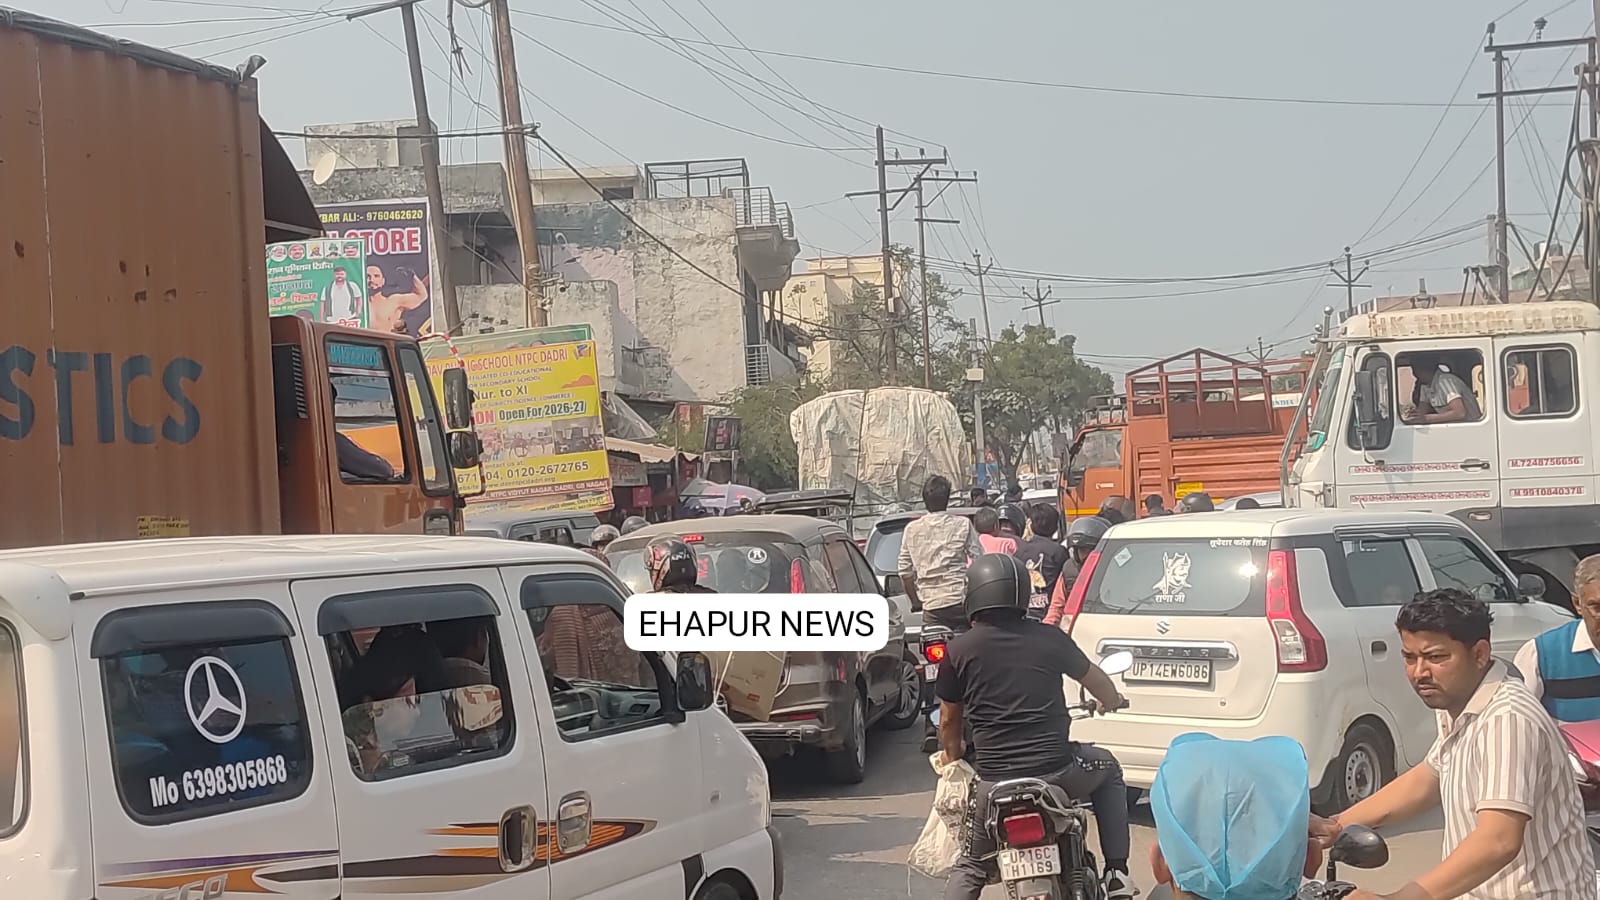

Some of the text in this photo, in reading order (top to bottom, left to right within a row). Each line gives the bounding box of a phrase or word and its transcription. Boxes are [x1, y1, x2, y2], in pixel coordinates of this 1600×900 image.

[366, 210, 423, 221] 9760462620
[478, 356, 513, 371] SCHOOL
[515, 353, 538, 365] NTPC
[540, 348, 567, 363] DADRI
[518, 375, 541, 383] SCHOOL
[500, 388, 512, 397] to
[516, 385, 527, 395] XI
[474, 401, 585, 424] ON Open For 2026-27
[507, 461, 589, 478] 0120-2672765
[1132, 662, 1208, 679] UP14EW6086
[150, 754, 287, 807] Mo 6398305868
[1010, 847, 1052, 863] UP16C
[1011, 861, 1053, 876] H1169
